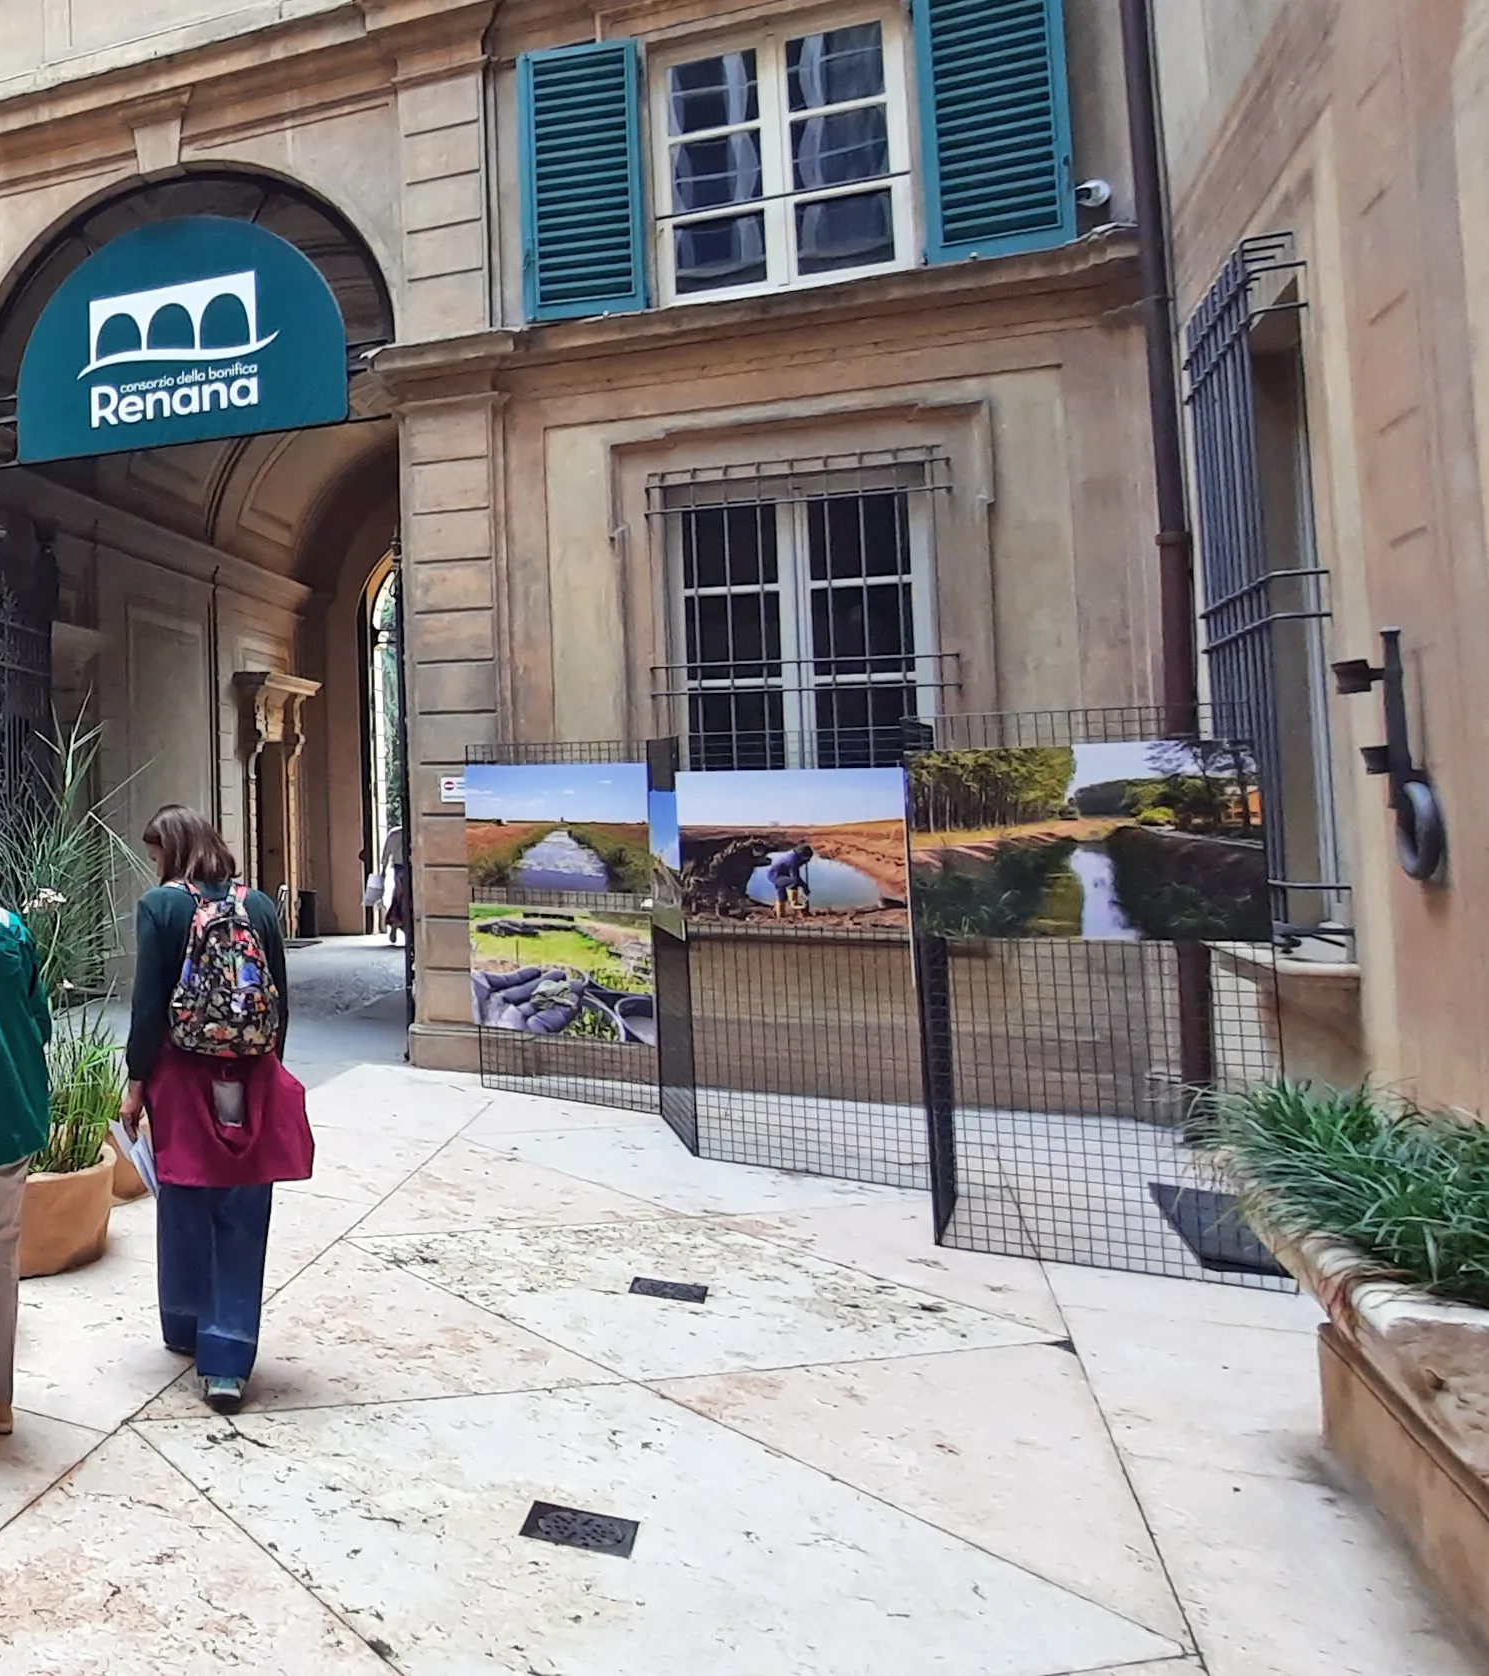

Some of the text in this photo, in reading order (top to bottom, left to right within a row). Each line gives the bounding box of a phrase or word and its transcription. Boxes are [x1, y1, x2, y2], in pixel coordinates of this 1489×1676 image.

[120, 361, 258, 393] consorzio della bonifica
[90, 376, 259, 428] Renana
